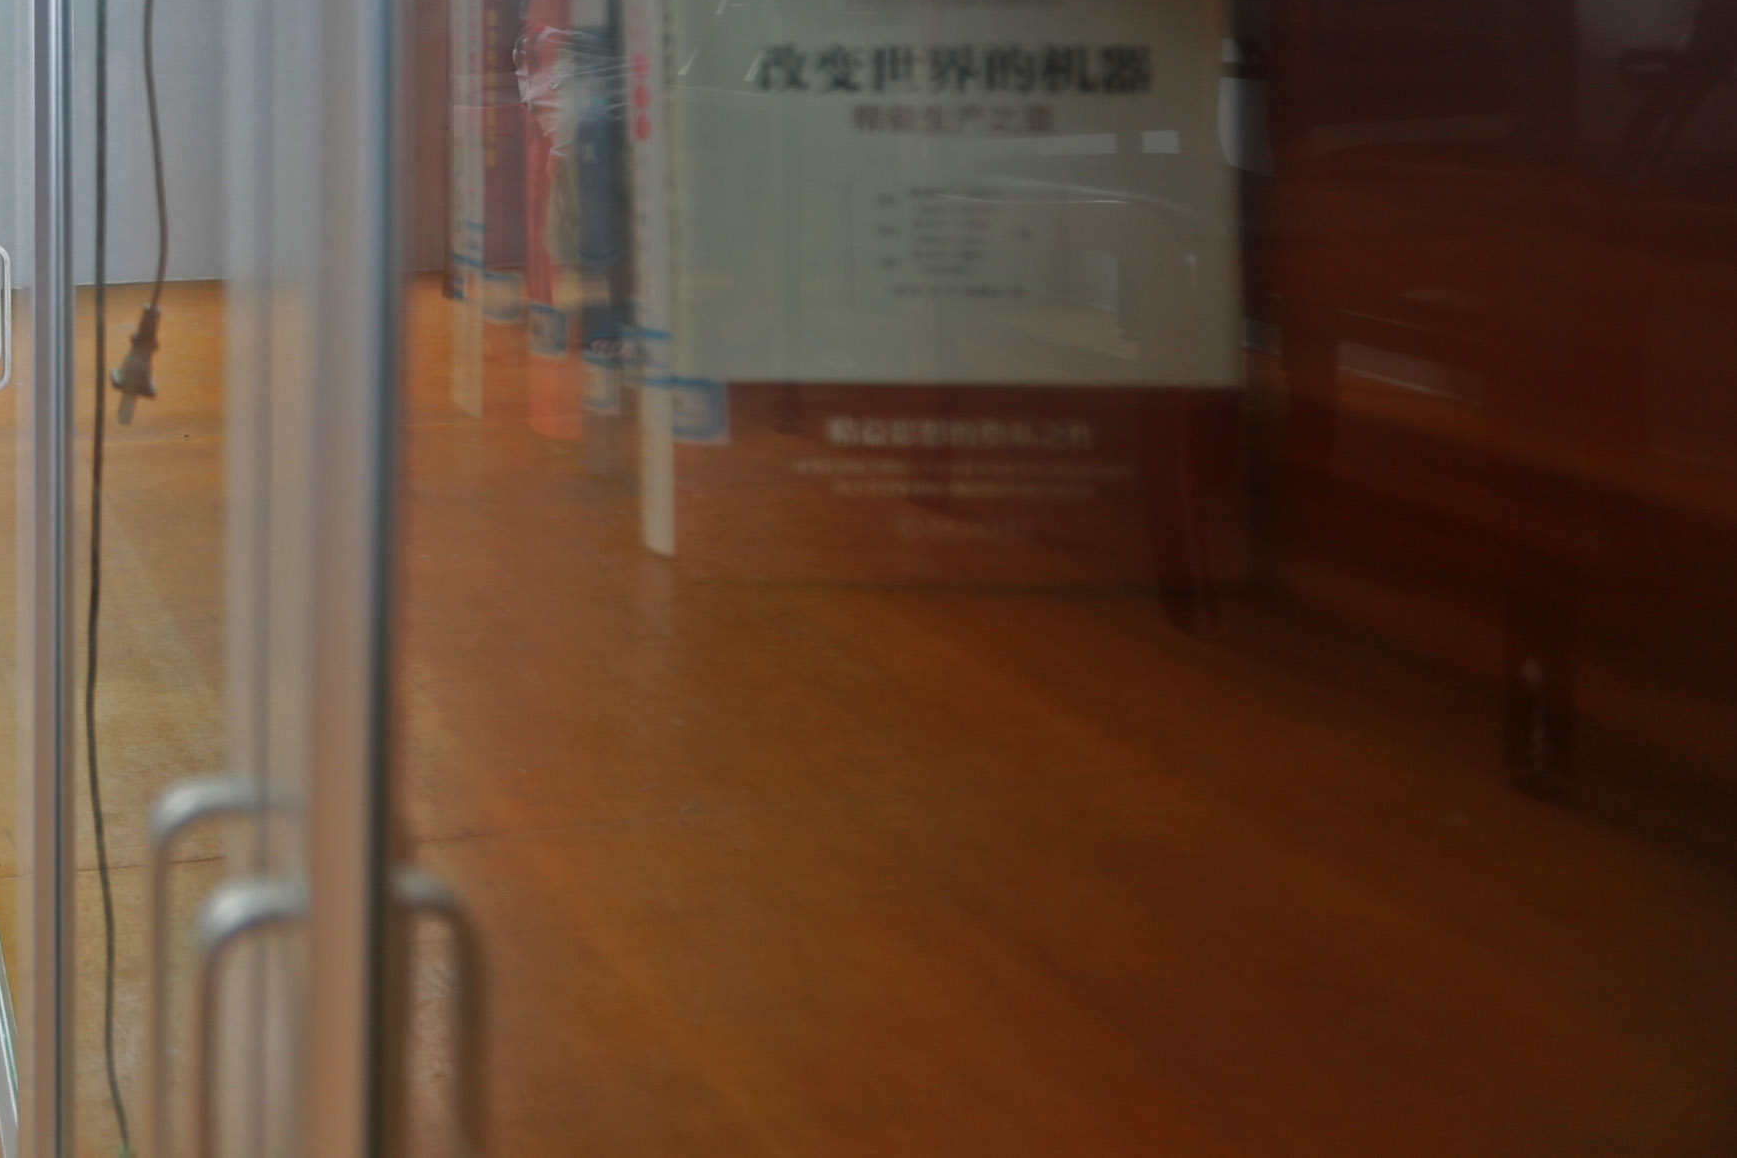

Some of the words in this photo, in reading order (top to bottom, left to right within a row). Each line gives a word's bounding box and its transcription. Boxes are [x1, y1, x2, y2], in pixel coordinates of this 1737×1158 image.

[756, 42, 1155, 95] 改变世界的机器
